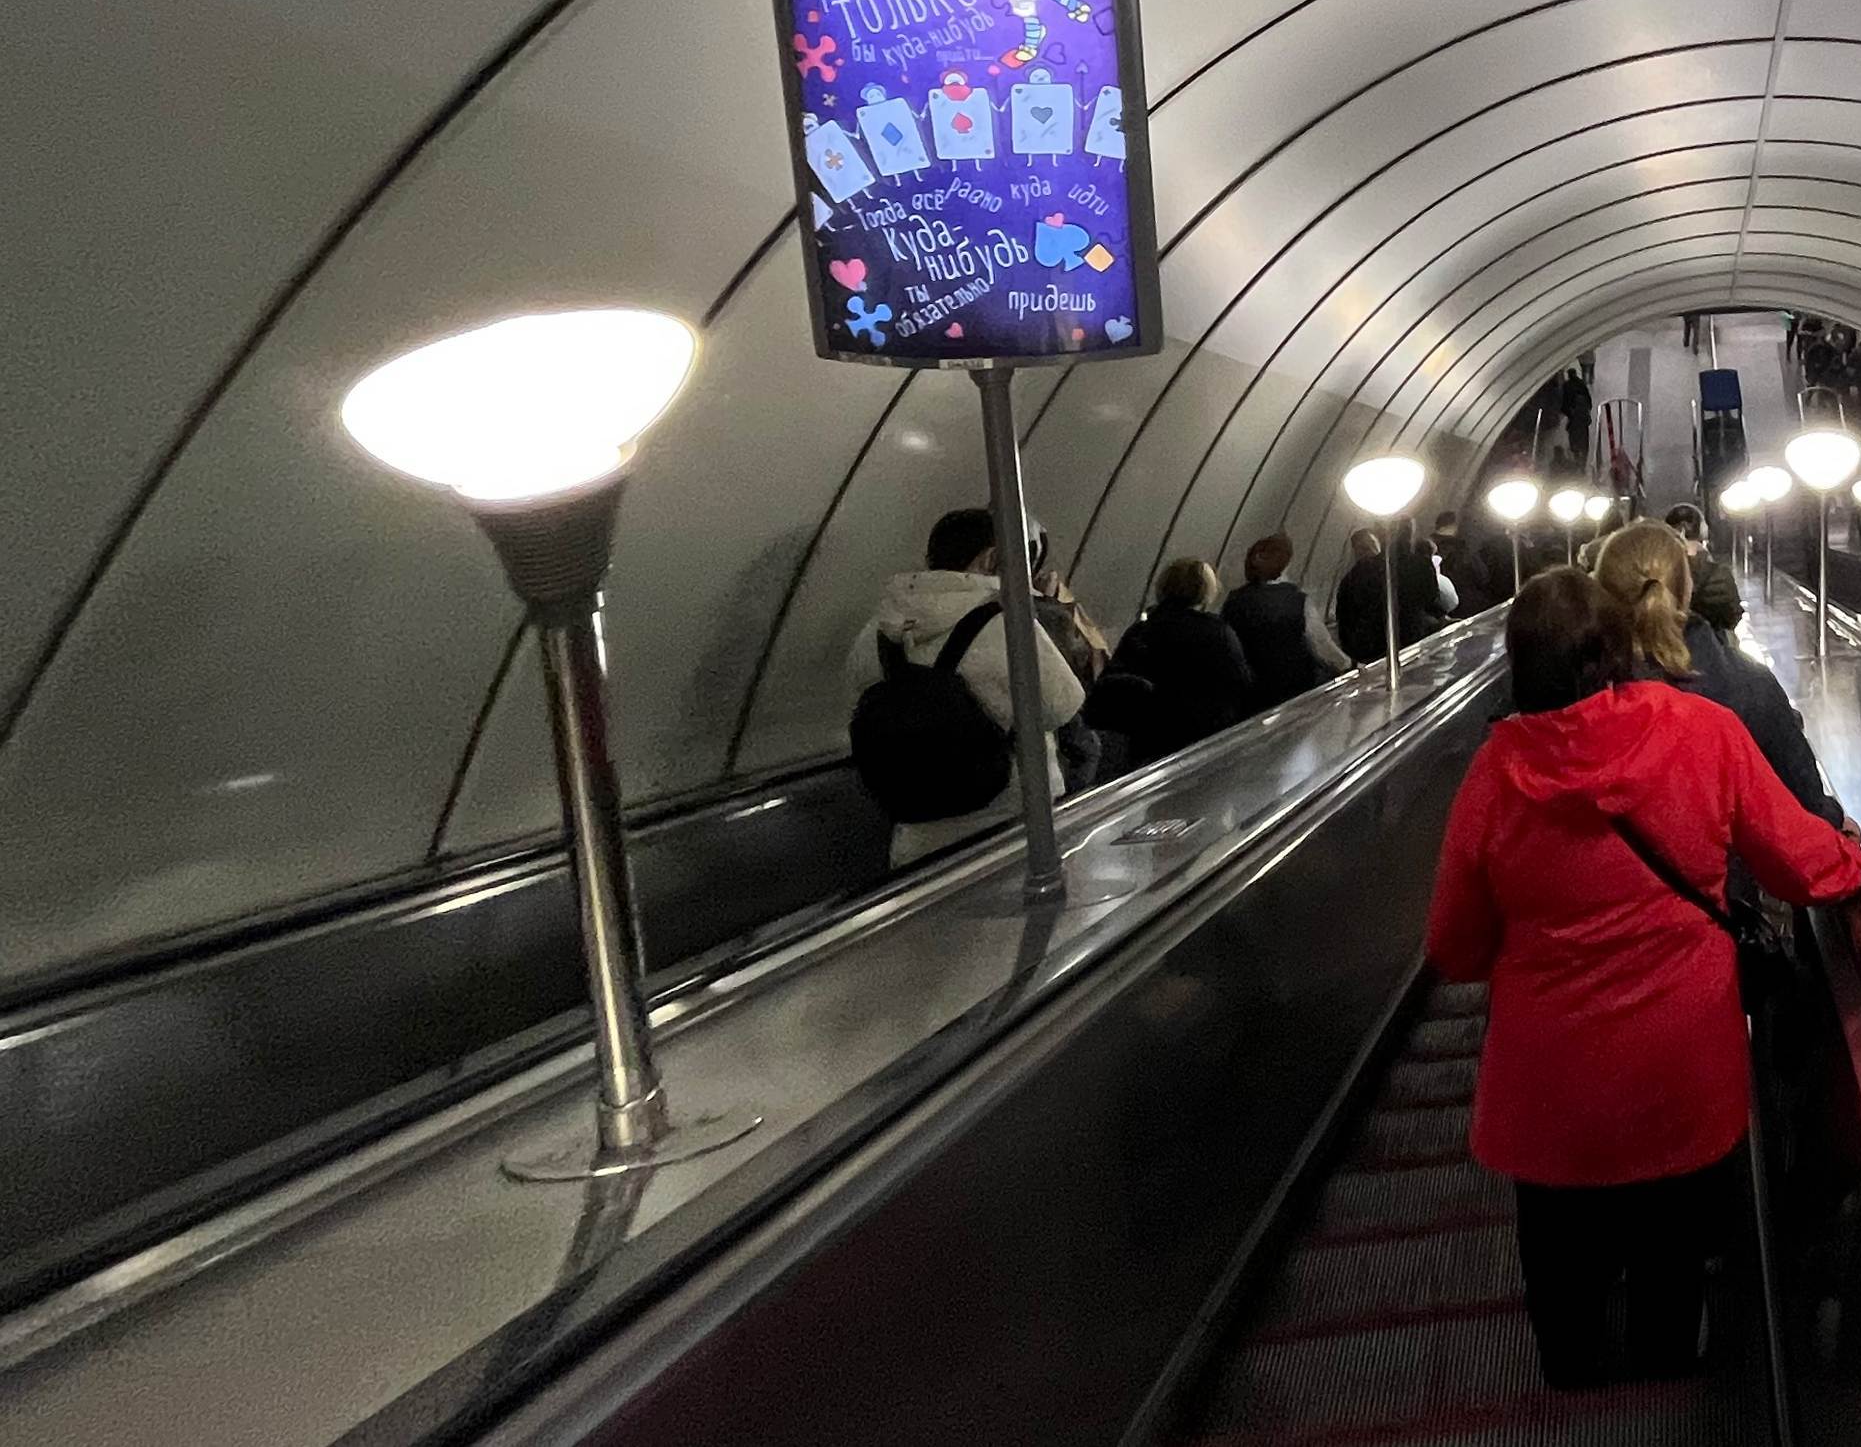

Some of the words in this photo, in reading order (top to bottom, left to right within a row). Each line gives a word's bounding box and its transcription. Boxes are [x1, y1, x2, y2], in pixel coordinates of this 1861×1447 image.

[851, 38, 876, 62] бы
[882, 7, 995, 72] куда-нибудь
[853, 198, 907, 231] Тогда
[911, 189, 946, 211] всё
[945, 176, 1003, 213] равно
[1009, 175, 1052, 207] куда
[1067, 183, 1110, 216] идти
[923, 229, 1030, 285] нибудь
[894, 277, 991, 338] обязательно
[904, 283, 931, 304] ты
[1008, 284, 1097, 321] придешь
